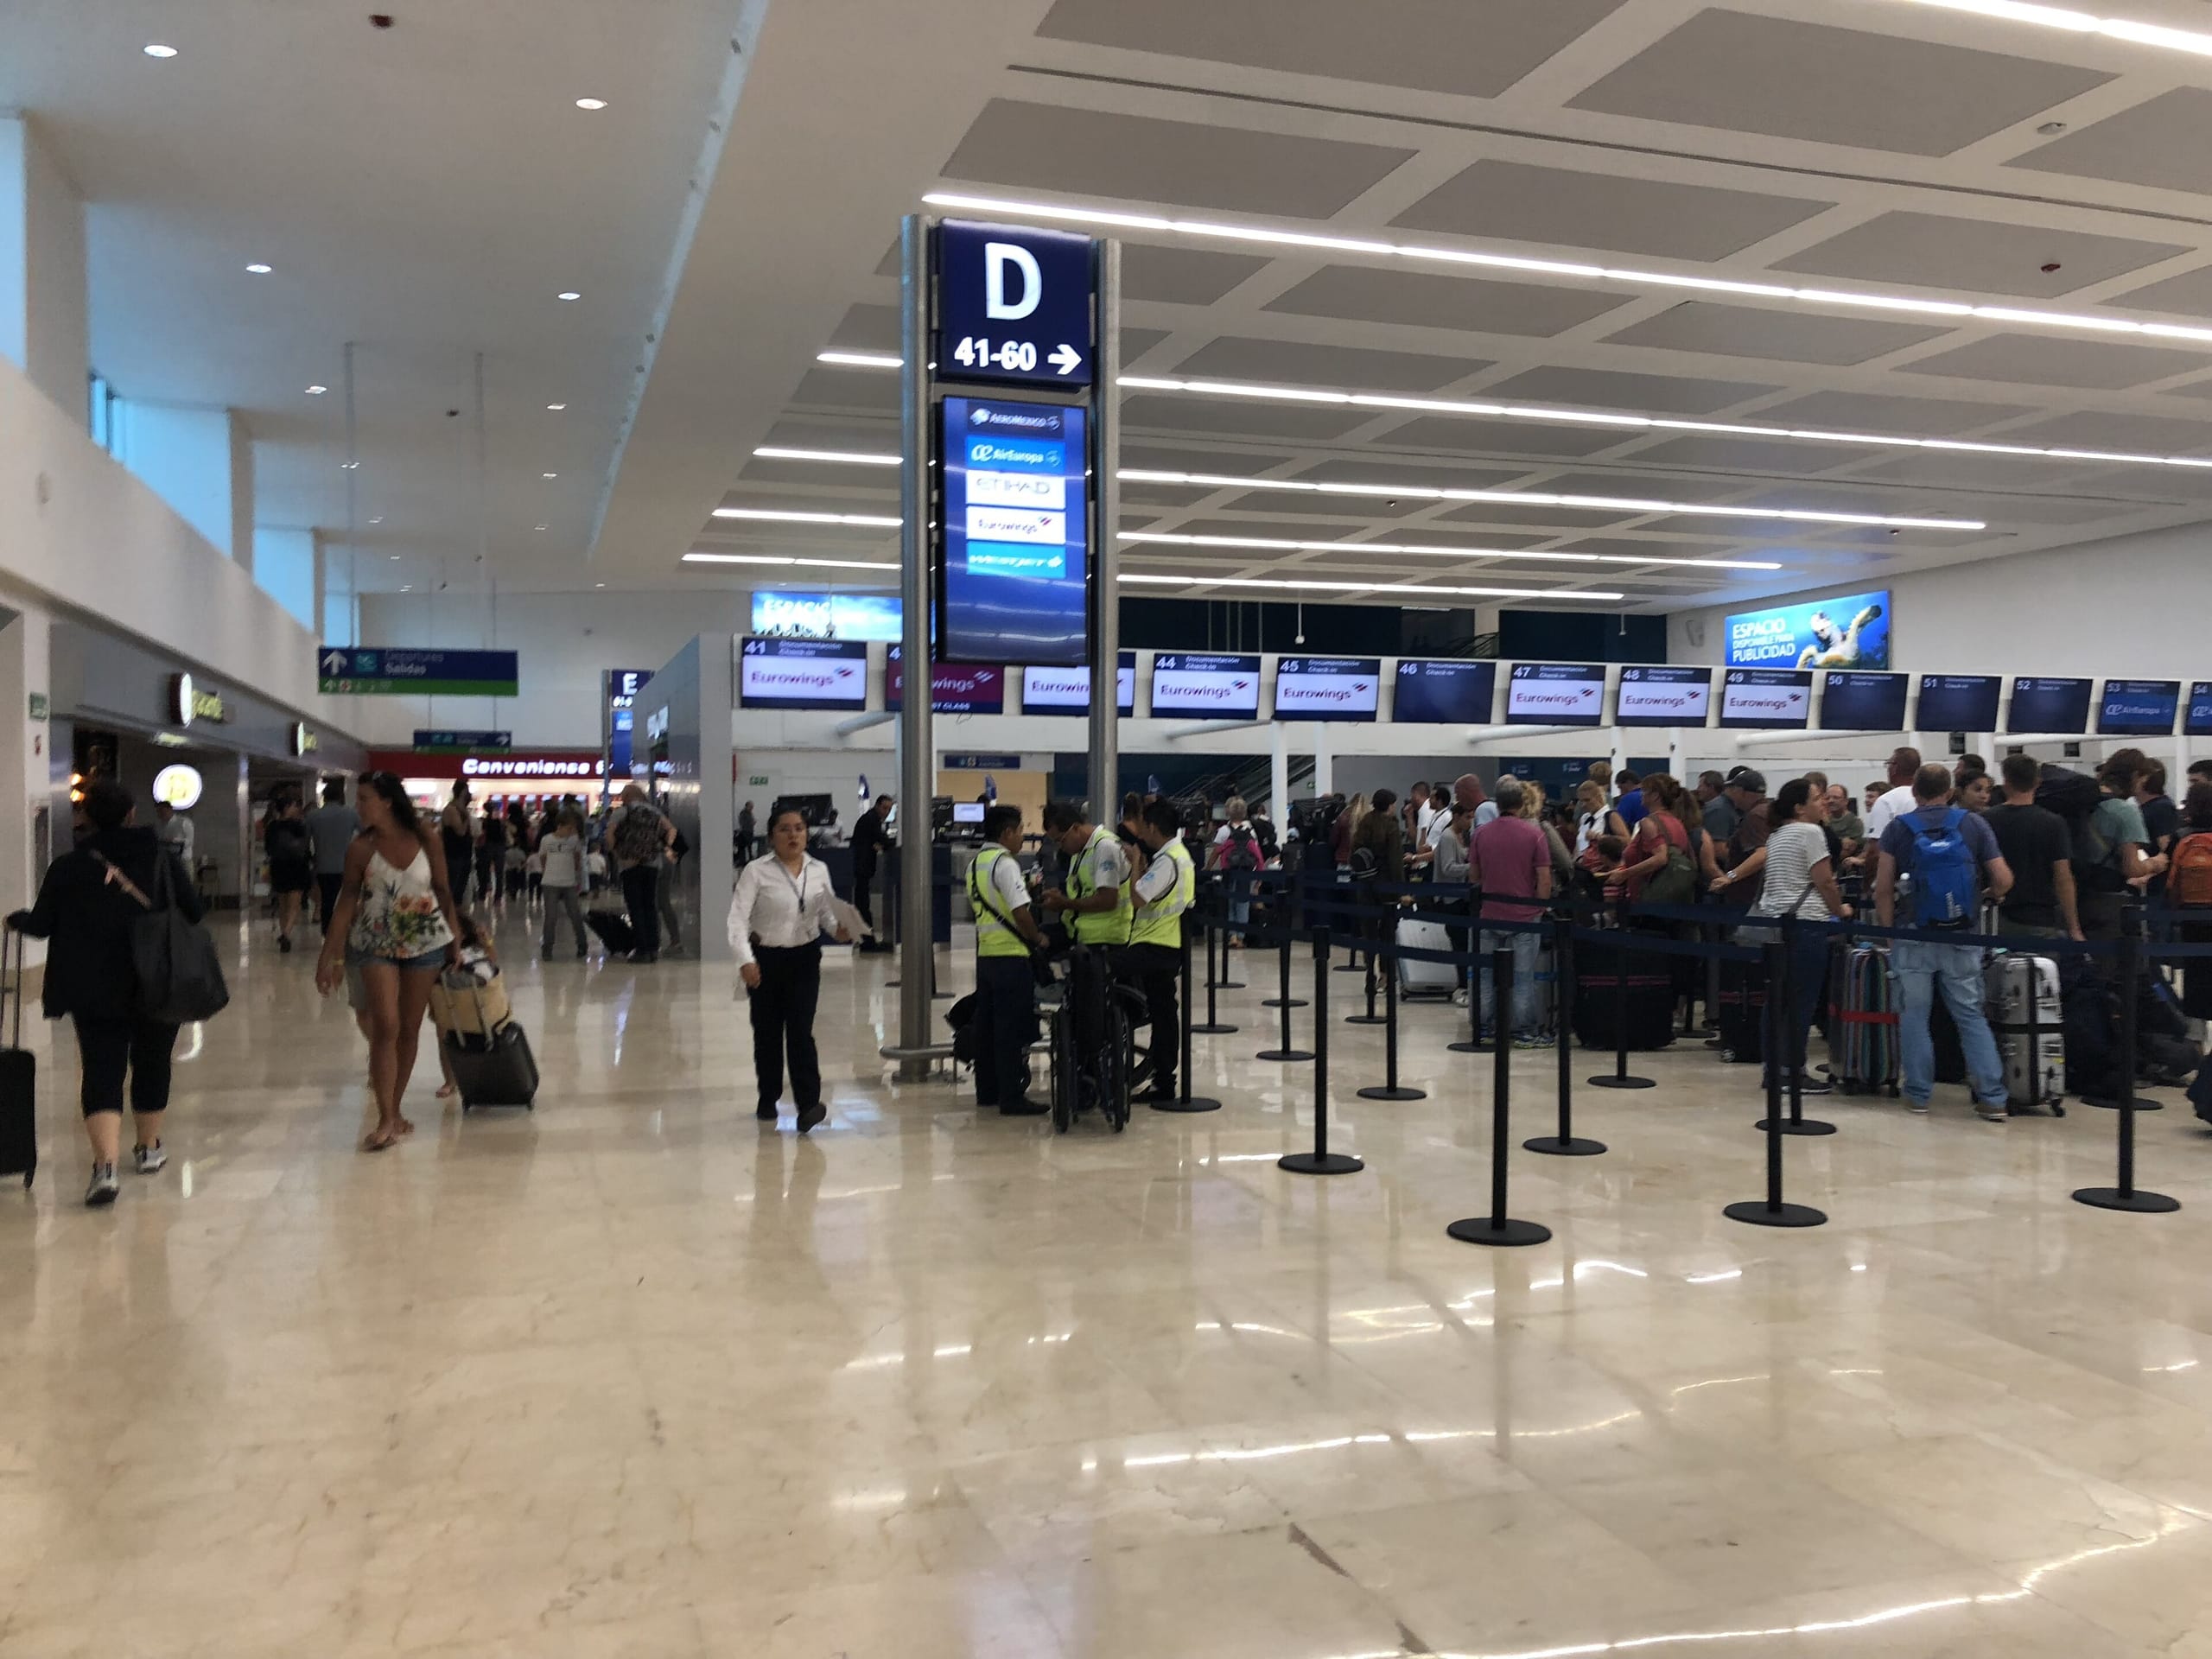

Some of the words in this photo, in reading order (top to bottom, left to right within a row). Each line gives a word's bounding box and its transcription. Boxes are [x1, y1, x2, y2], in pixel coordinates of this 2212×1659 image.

[985, 242, 1042, 320] D
[954, 337, 1037, 372] 41-60
[976, 477, 1051, 495] ETIHAD
[1732, 618, 1785, 639] ESPACIO
[744, 640, 766, 654] 41
[1732, 643, 1796, 663] PUBLICIDAD
[1156, 657, 1176, 668] 44
[1280, 660, 1300, 671] 45
[1400, 663, 1418, 675] 46
[1514, 666, 1532, 677] 47
[1623, 669, 1640, 680] 48
[752, 671, 834, 687] Eurowings
[1728, 672, 1744, 683] 49
[1827, 675, 1843, 685] 50
[1923, 678, 1937, 688] 51
[623, 673, 638, 695] E
[1032, 680, 1090, 692] Eurowin
[2017, 680, 2031, 690] 52
[2108, 683, 2120, 692] 53
[1160, 685, 1231, 700] Eurowings
[1284, 688, 1351, 702] Eurowings
[1516, 693, 1579, 705] Eurowings
[1625, 696, 1686, 708] Eurowings
[1730, 697, 1787, 710] Eurowings
[462, 759, 590, 774] Convenience
